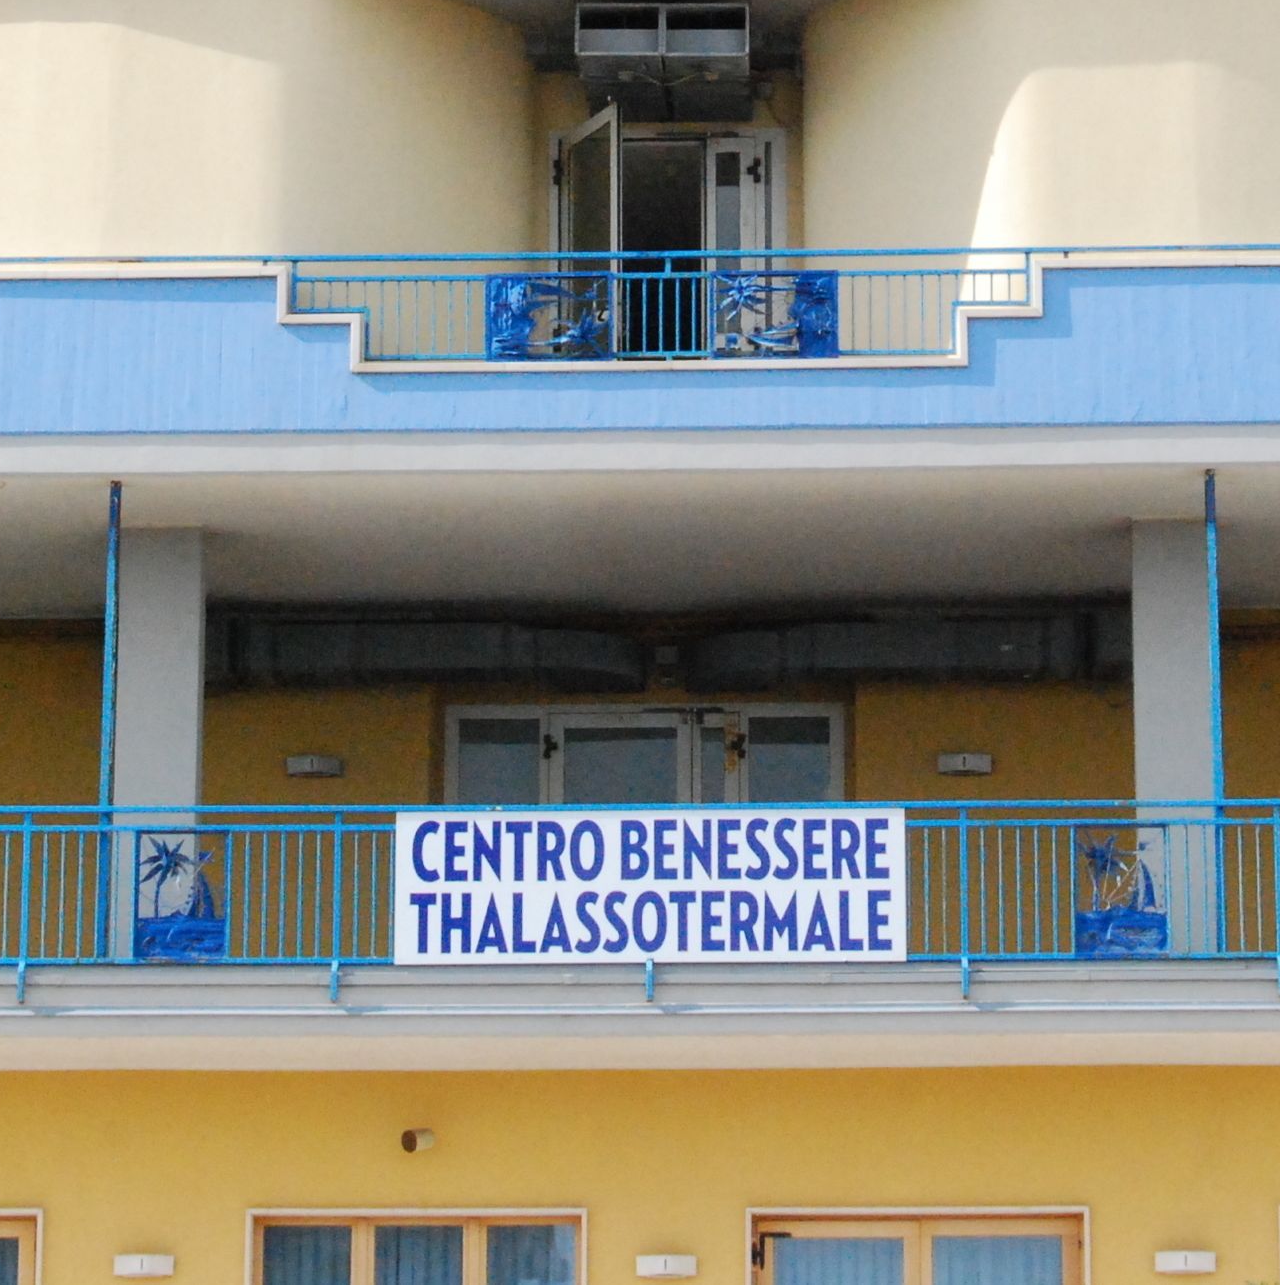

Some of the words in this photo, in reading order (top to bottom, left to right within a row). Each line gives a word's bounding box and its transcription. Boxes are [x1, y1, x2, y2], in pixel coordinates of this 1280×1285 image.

[412, 819, 605, 882] CENTRO
[621, 817, 890, 881] BENESSERE
[410, 889, 892, 954] THALASSOTERMALE
